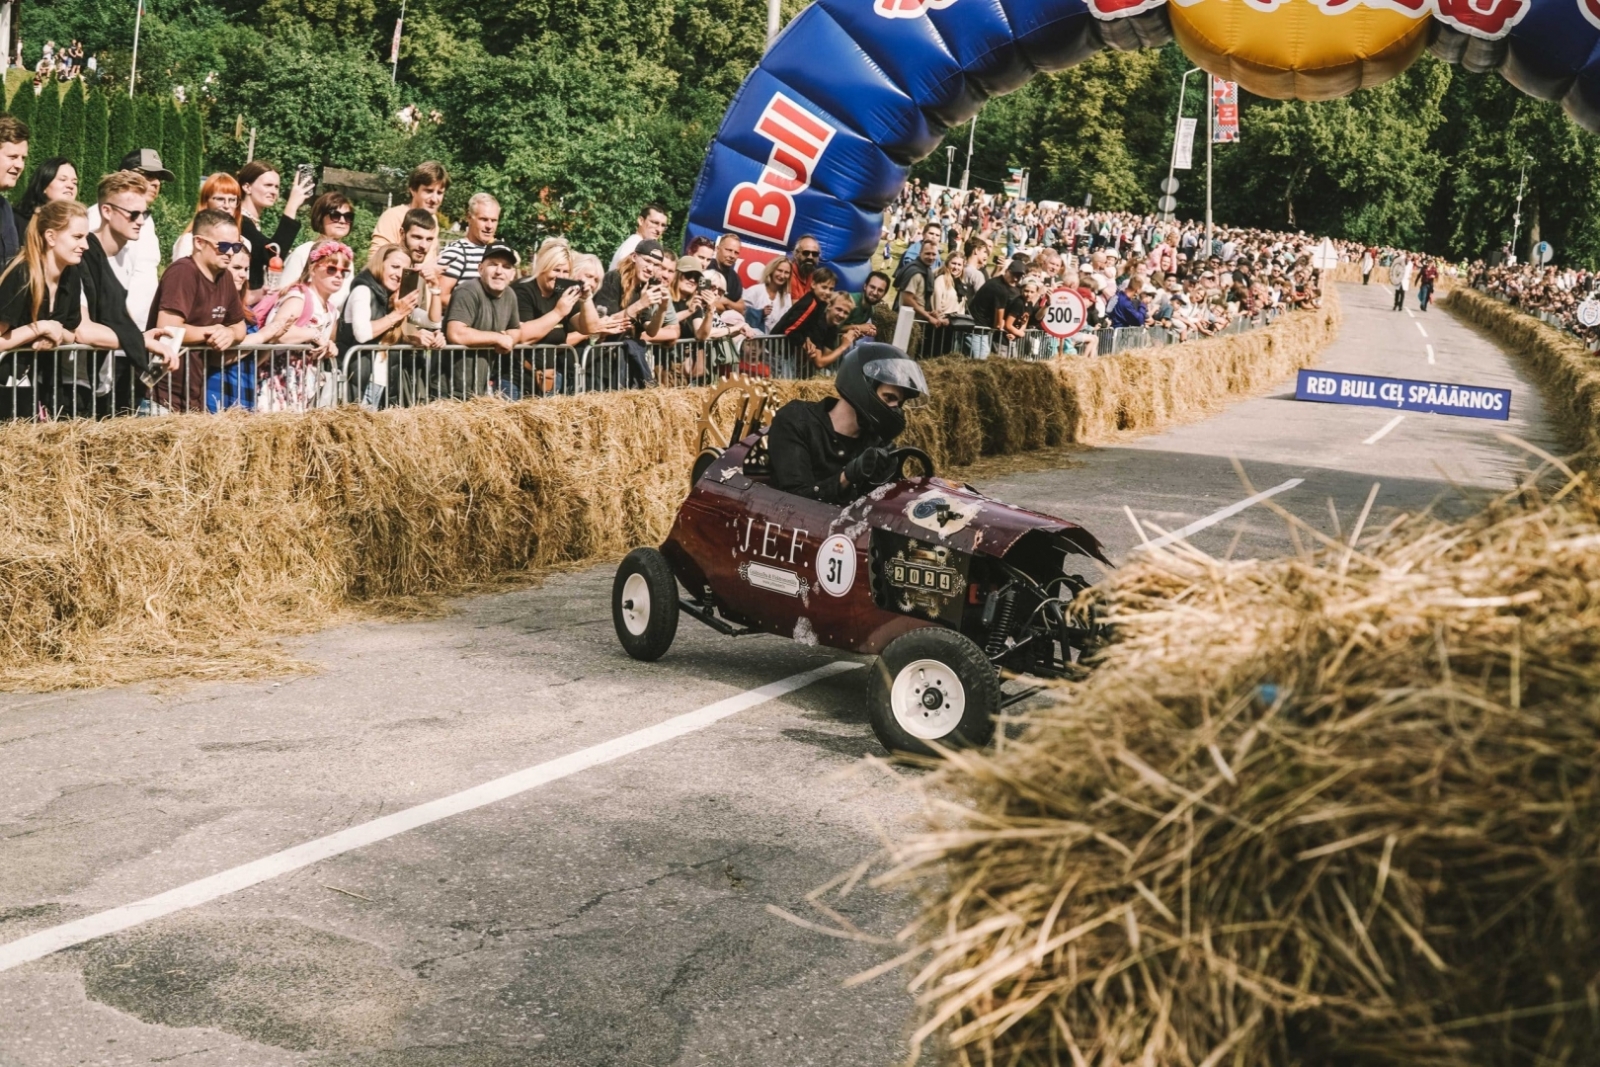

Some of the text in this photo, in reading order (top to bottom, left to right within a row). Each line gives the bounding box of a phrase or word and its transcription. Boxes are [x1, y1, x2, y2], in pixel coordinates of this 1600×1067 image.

[725, 95, 833, 244] Bull
[1047, 306, 1072, 323] 500
[1306, 376, 1503, 411] RED BULL CEĻ SPĀĀĀRNOS
[739, 517, 809, 568] J.E.F.
[826, 557, 843, 585] 31
